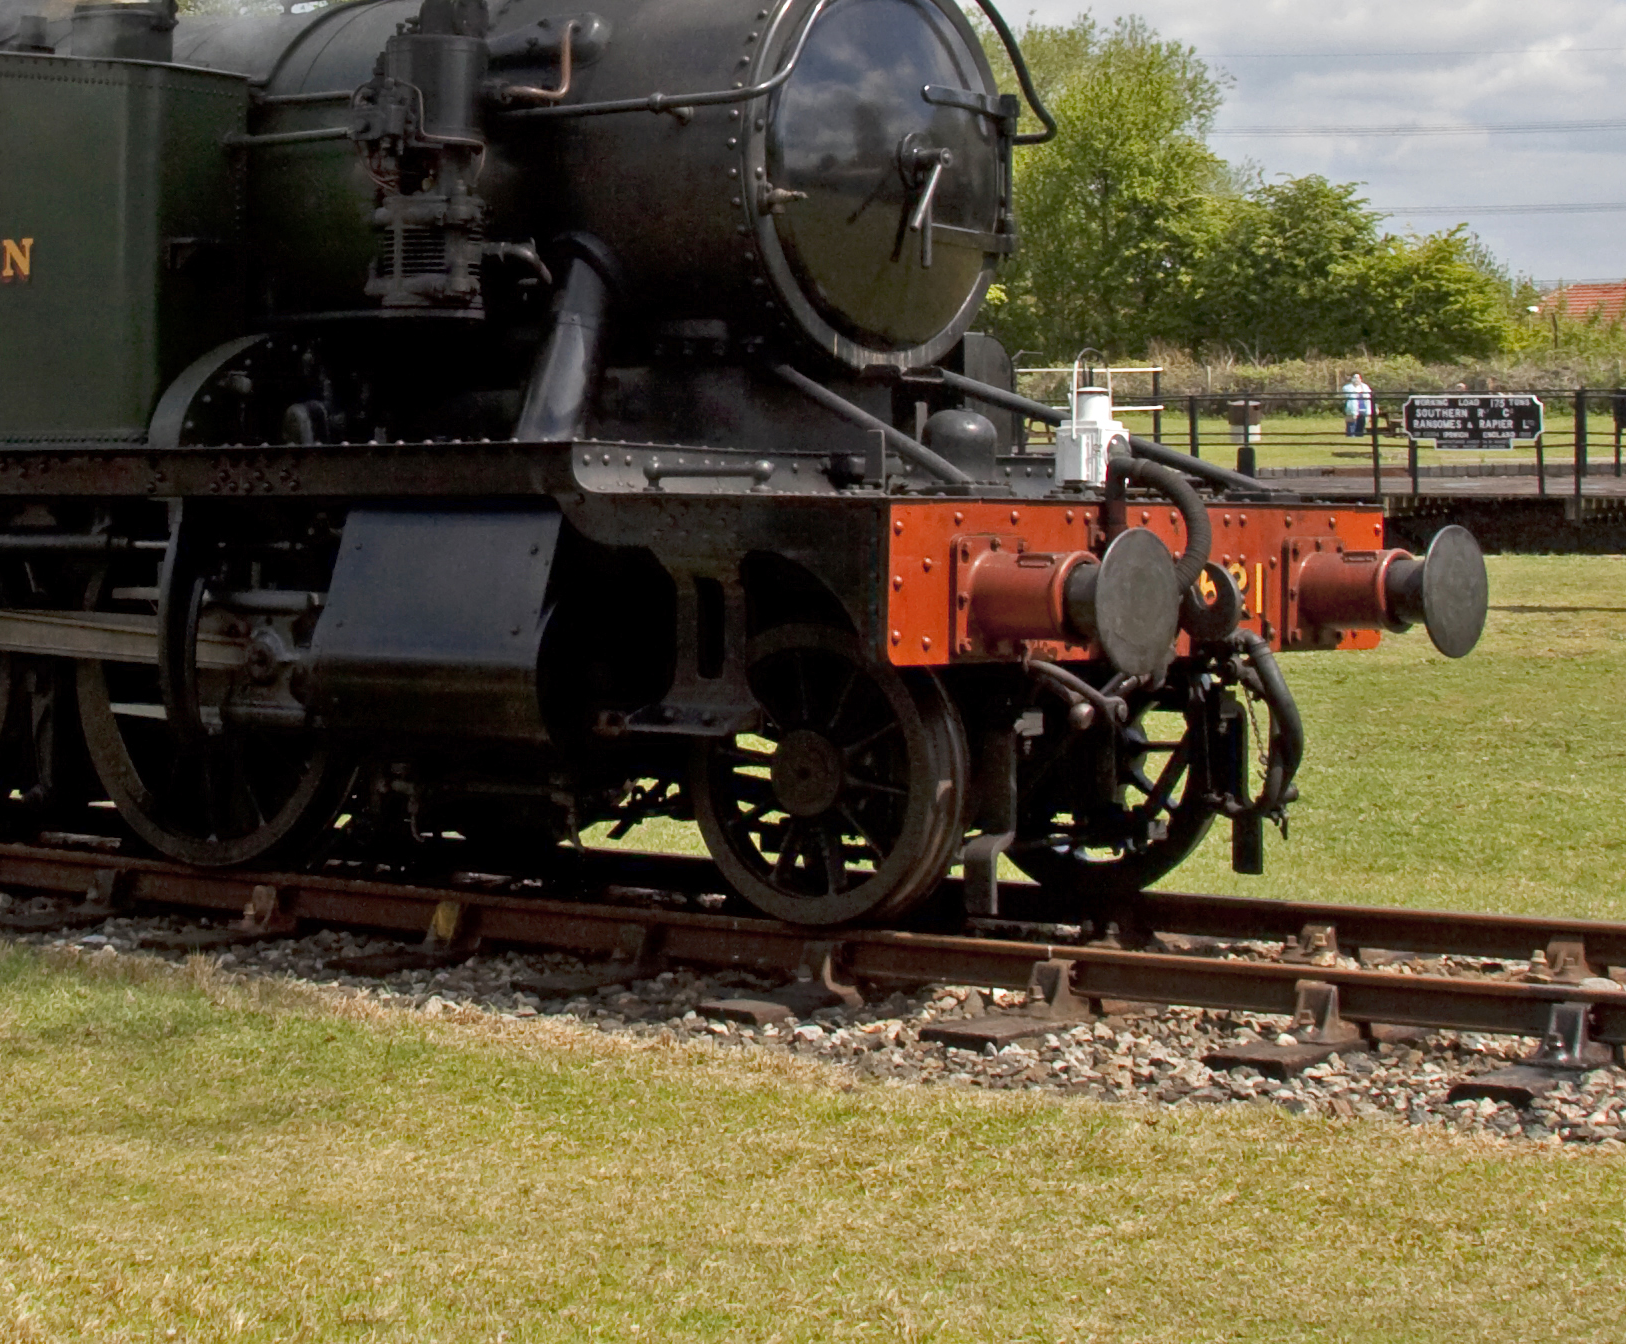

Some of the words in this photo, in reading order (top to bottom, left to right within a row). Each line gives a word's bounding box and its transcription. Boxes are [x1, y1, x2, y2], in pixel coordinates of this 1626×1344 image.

[1414, 398, 1449, 406] WORKING
[1458, 398, 1480, 406] LOAD
[1490, 398, 1505, 408] 175
[1508, 398, 1530, 406] TONS
[1416, 408, 1468, 417] SOUTHERN
[1413, 419, 1462, 429] RANSOMES
[1467, 421, 1474, 429] &
[1479, 419, 1513, 429] RAPIER
